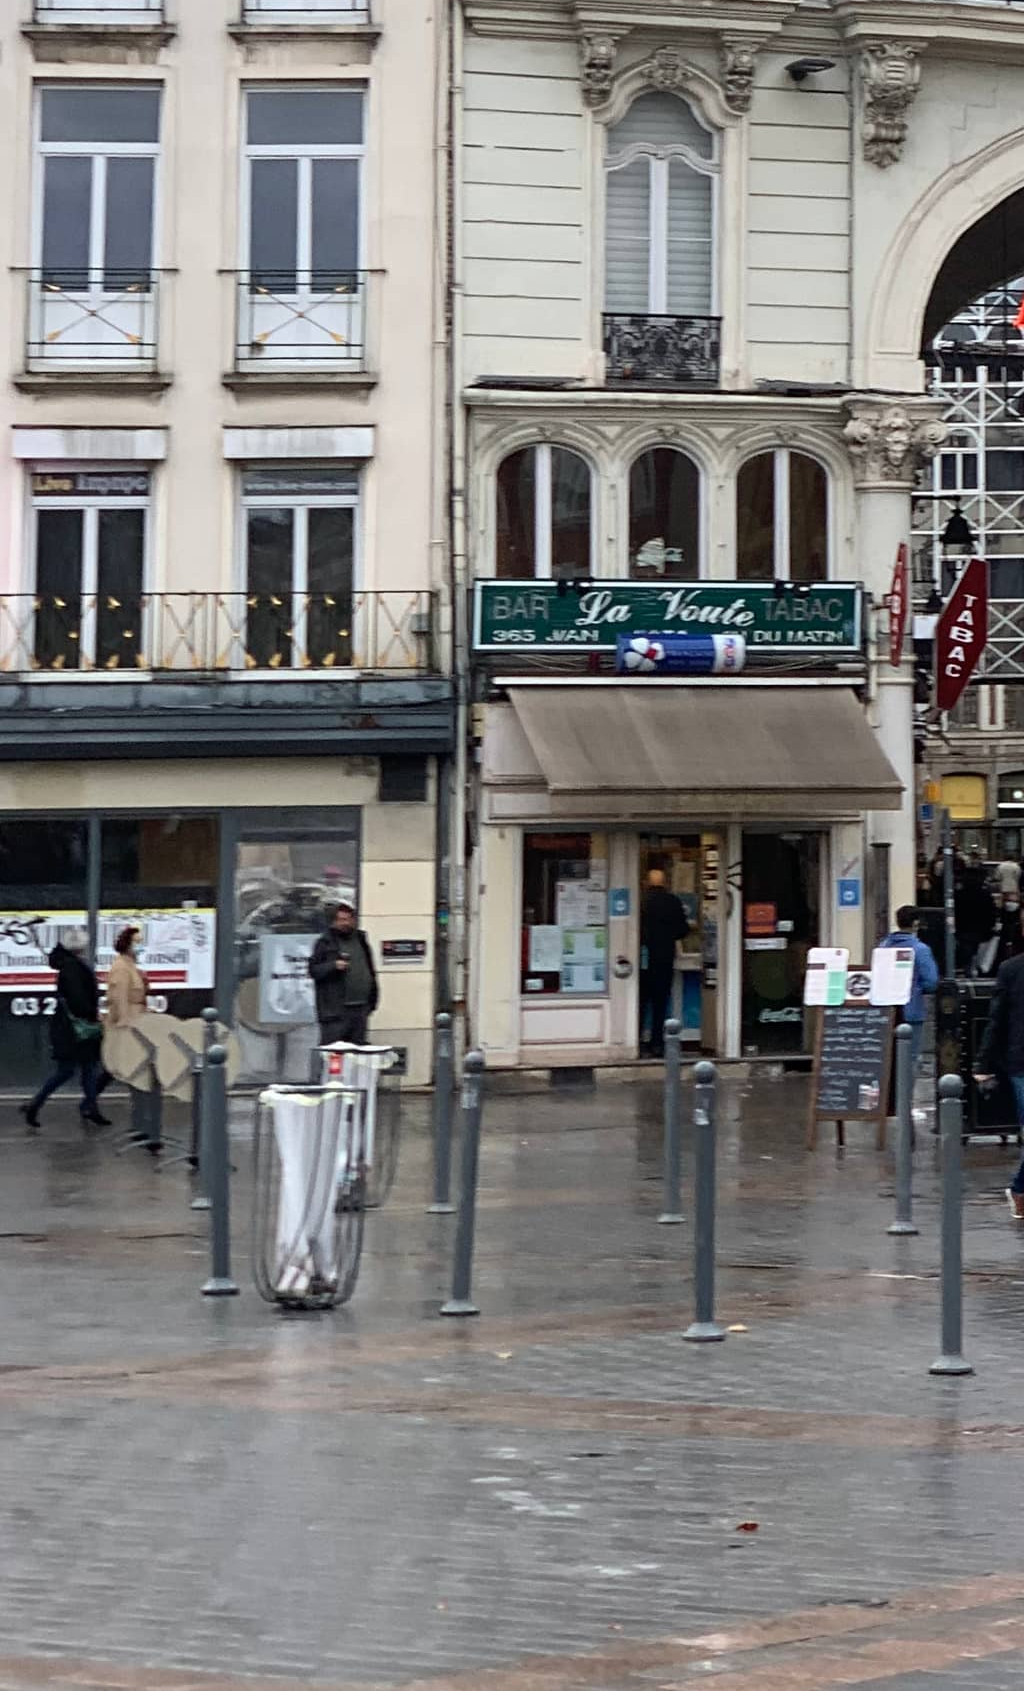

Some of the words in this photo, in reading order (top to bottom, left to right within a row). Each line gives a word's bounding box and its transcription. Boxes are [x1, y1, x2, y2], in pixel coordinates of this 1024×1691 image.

[493, 596, 549, 620] BAR
[575, 591, 632, 626] La
[761, 598, 844, 622] TABAC
[492, 629, 536, 642] 365
[752, 630, 782, 643] DU
[944, 593, 979, 678] TABAC
[11, 996, 40, 1016] 03
